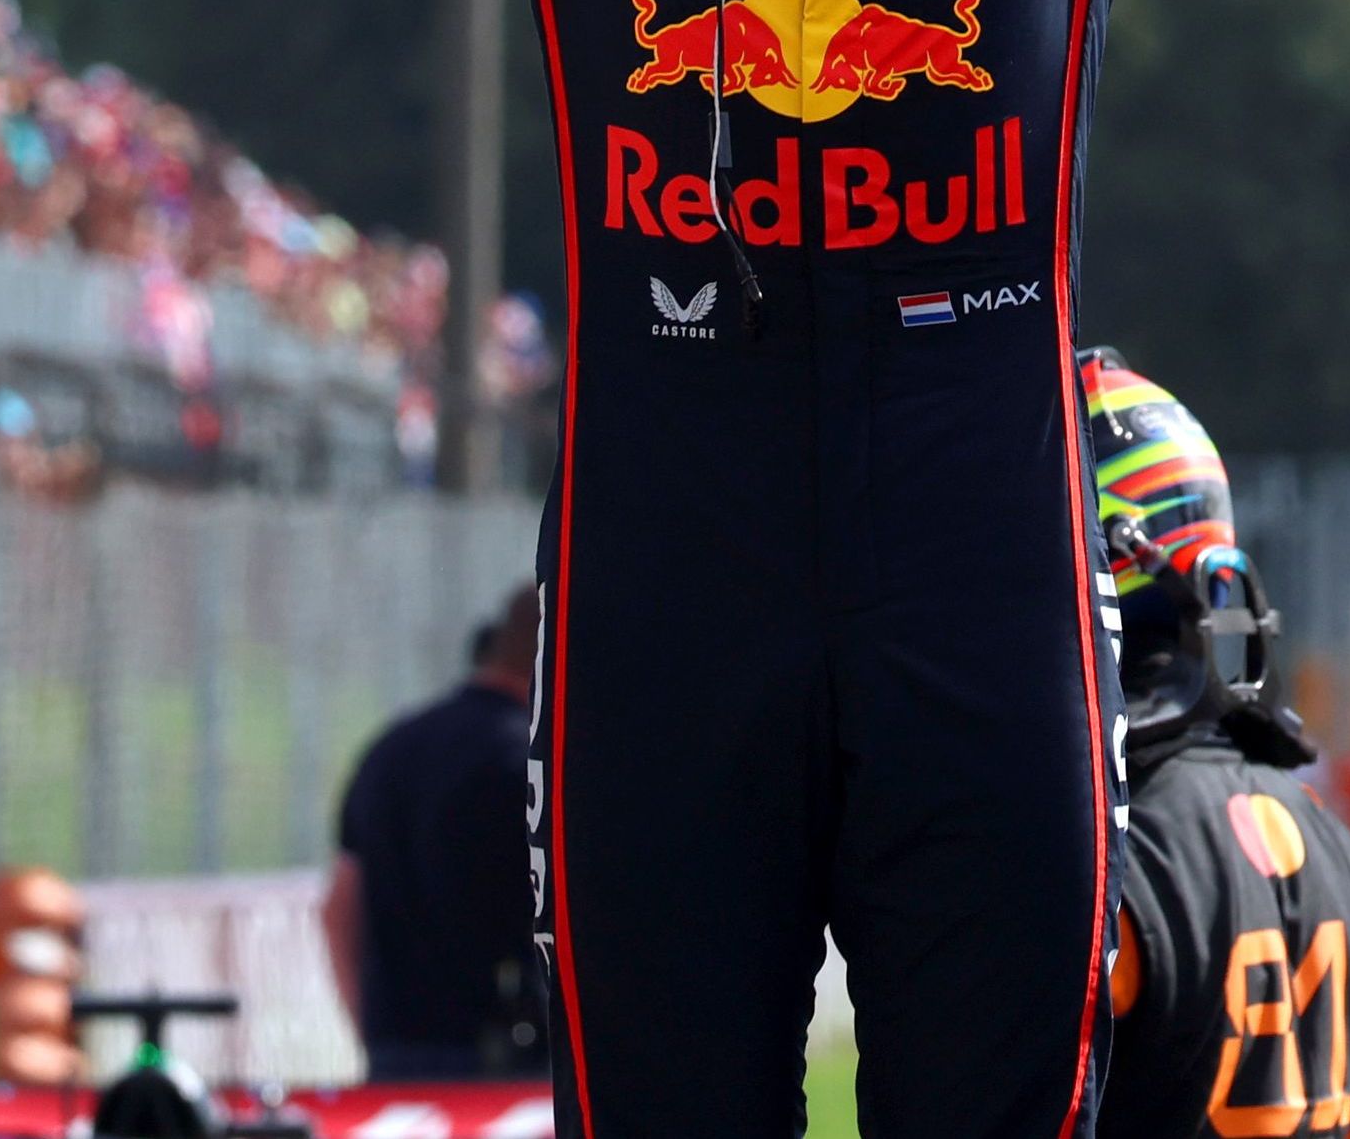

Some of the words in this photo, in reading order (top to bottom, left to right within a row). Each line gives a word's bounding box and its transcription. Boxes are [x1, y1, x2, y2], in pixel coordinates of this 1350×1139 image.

[604, 124, 802, 247] Red
[822, 116, 1026, 250] Bull
[962, 280, 1042, 315] MAX
[652, 324, 716, 339] CASTORE
